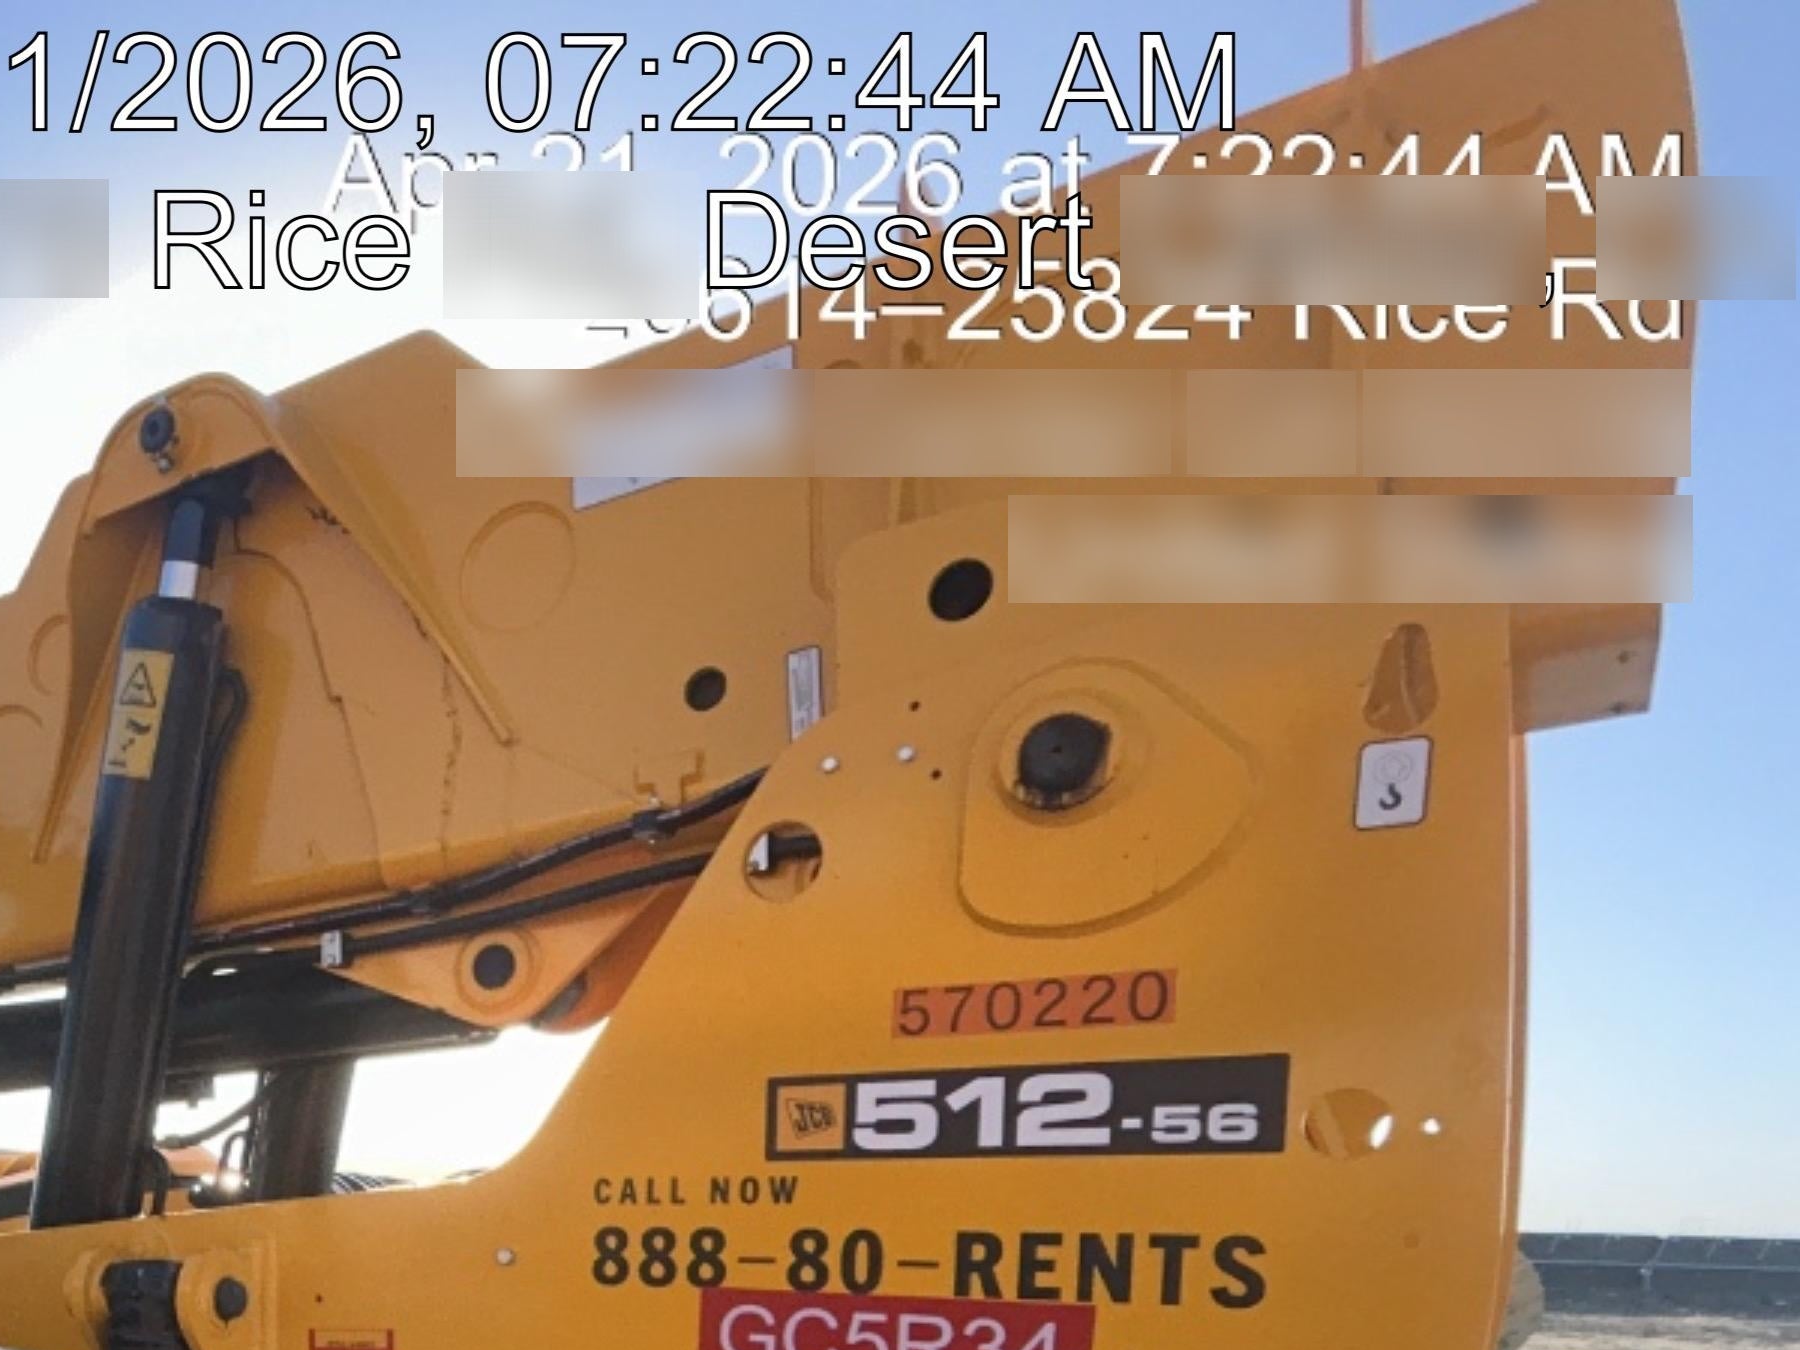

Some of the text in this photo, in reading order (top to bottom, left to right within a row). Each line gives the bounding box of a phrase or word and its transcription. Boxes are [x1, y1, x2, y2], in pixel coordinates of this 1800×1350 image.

[897, 970, 1169, 1037] 570220
[851, 1073, 1261, 1151] 512-56
[593, 1175, 802, 1206] CALL NOW
[592, 1225, 1268, 1309] 888-80-RENTS
